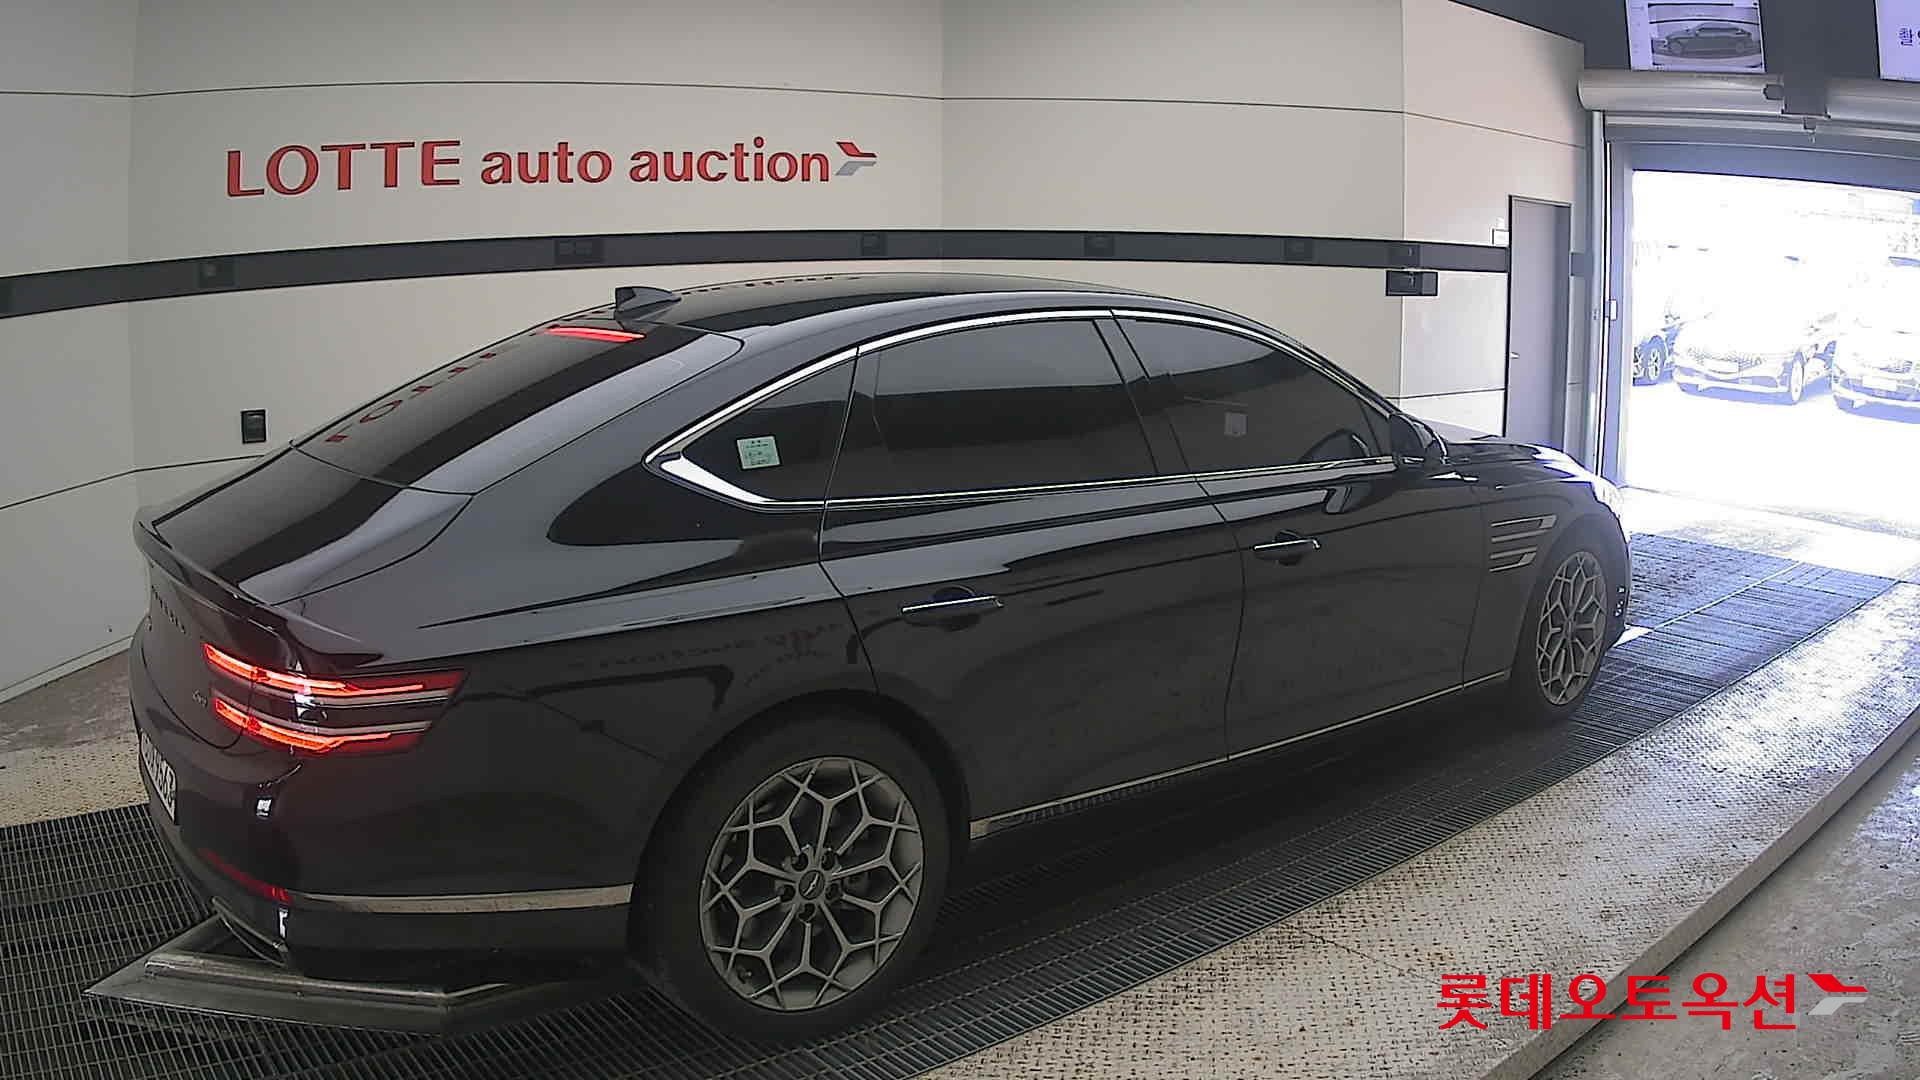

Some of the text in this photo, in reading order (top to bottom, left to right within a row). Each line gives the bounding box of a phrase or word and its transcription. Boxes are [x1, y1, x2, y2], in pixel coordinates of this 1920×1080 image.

[226, 137, 831, 198] LOTTE auto auction
